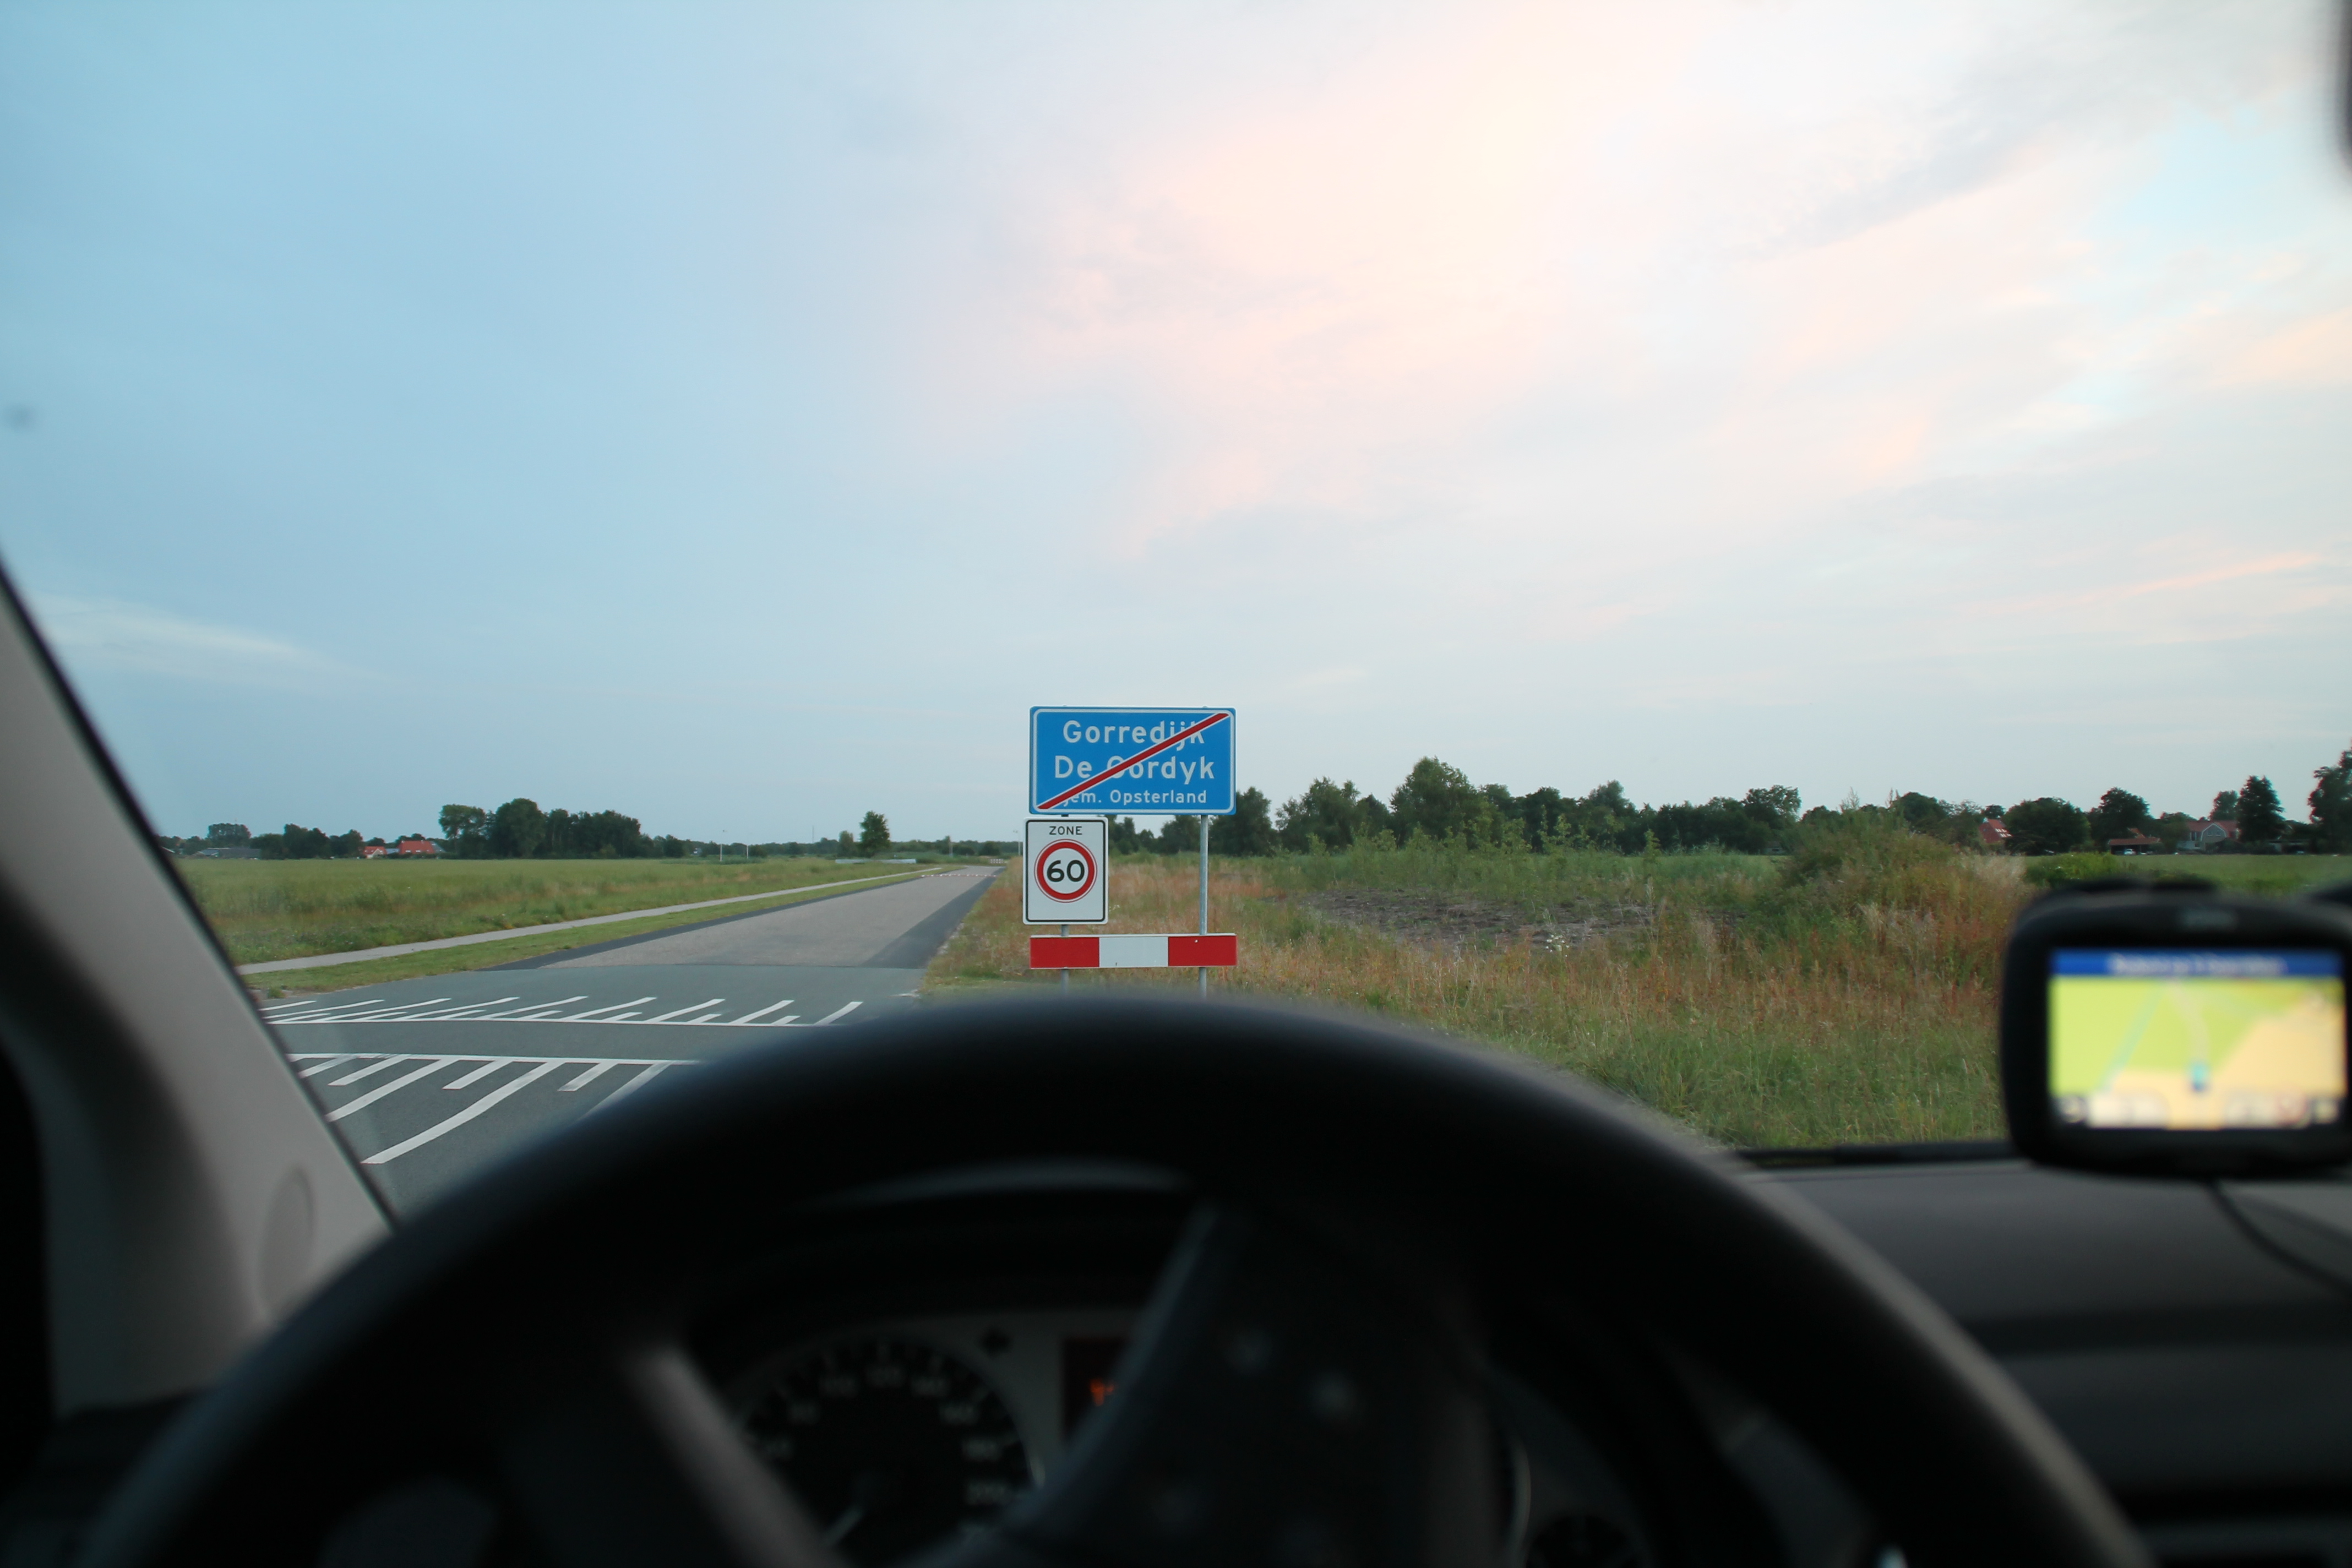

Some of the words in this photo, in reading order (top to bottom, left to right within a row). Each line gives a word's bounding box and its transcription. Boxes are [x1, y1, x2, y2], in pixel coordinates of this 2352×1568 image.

[1063, 720, 1205, 751] Gorredijk
[1054, 755, 1092, 778] De
[1110, 790, 1206, 805] Opsterland
[1049, 826, 1082, 835] ZONE
[1047, 859, 1085, 883] 60
